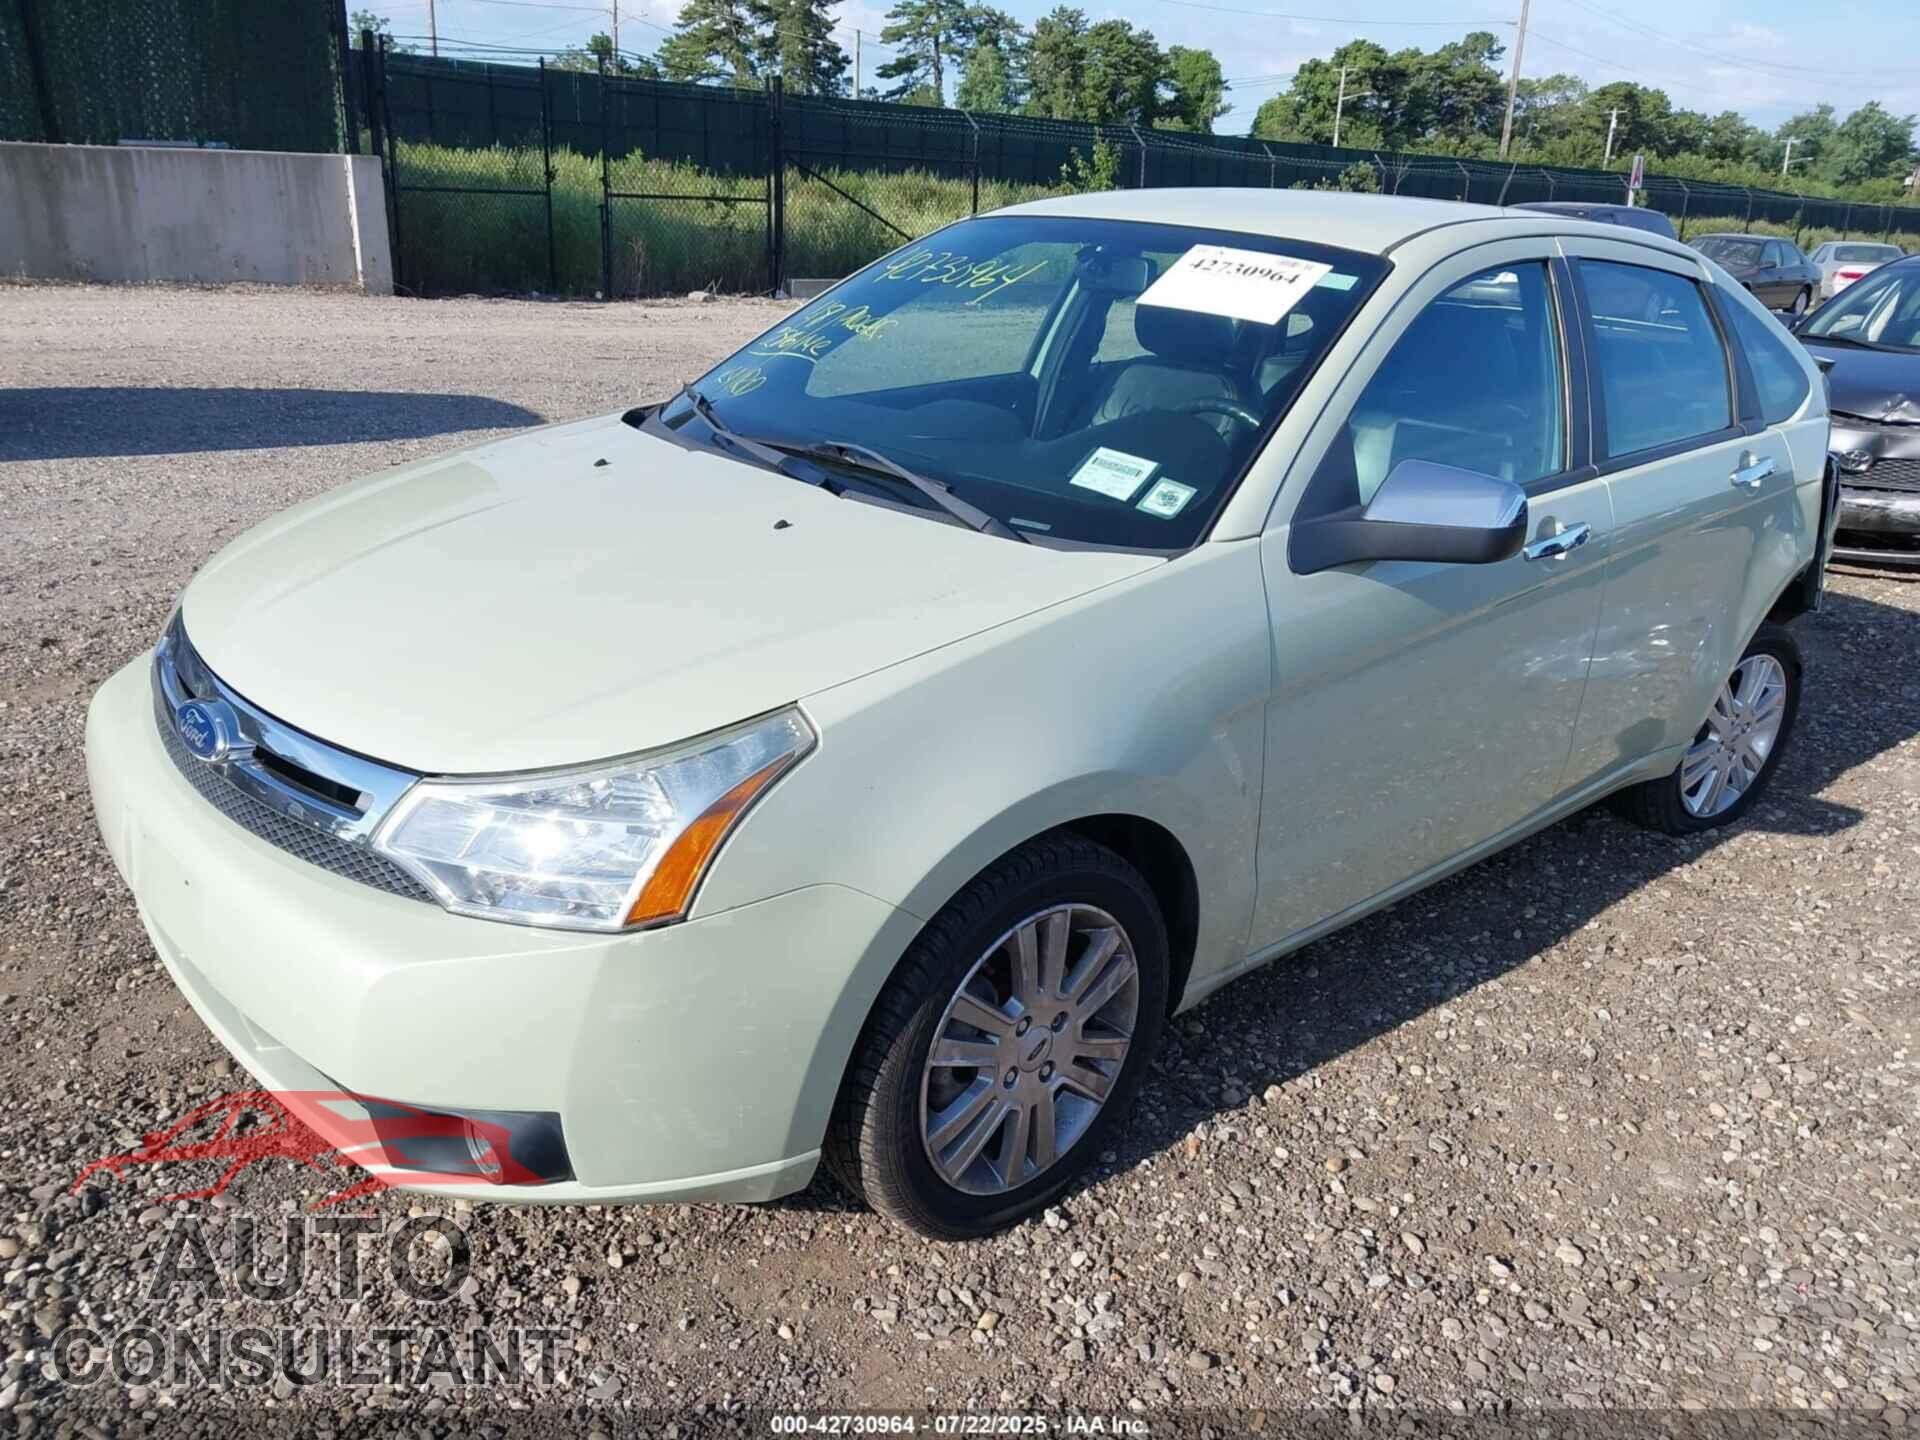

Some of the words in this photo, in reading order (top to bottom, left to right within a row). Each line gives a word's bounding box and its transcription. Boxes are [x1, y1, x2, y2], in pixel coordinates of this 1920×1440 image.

[873, 246, 1048, 305] 42730964
[1189, 258, 1301, 284] 42730964
[181, 708, 209, 748] Ford
